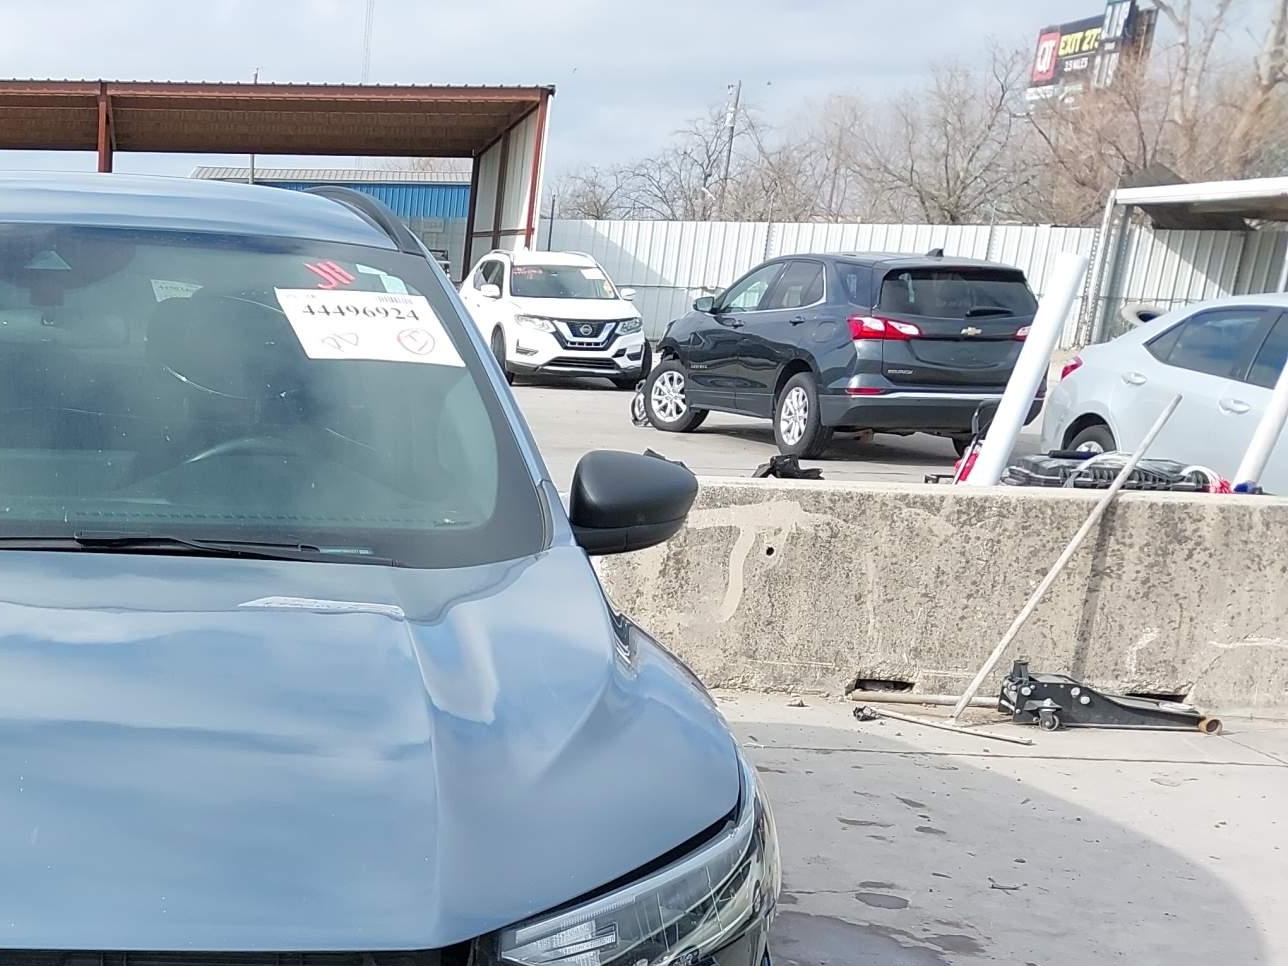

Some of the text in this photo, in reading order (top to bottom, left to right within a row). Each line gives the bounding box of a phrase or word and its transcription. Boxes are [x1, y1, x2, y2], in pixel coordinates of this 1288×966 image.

[1037, 40, 1055, 72] QT
[1058, 32, 1083, 56] EXIT
[302, 303, 420, 321] 44496924
